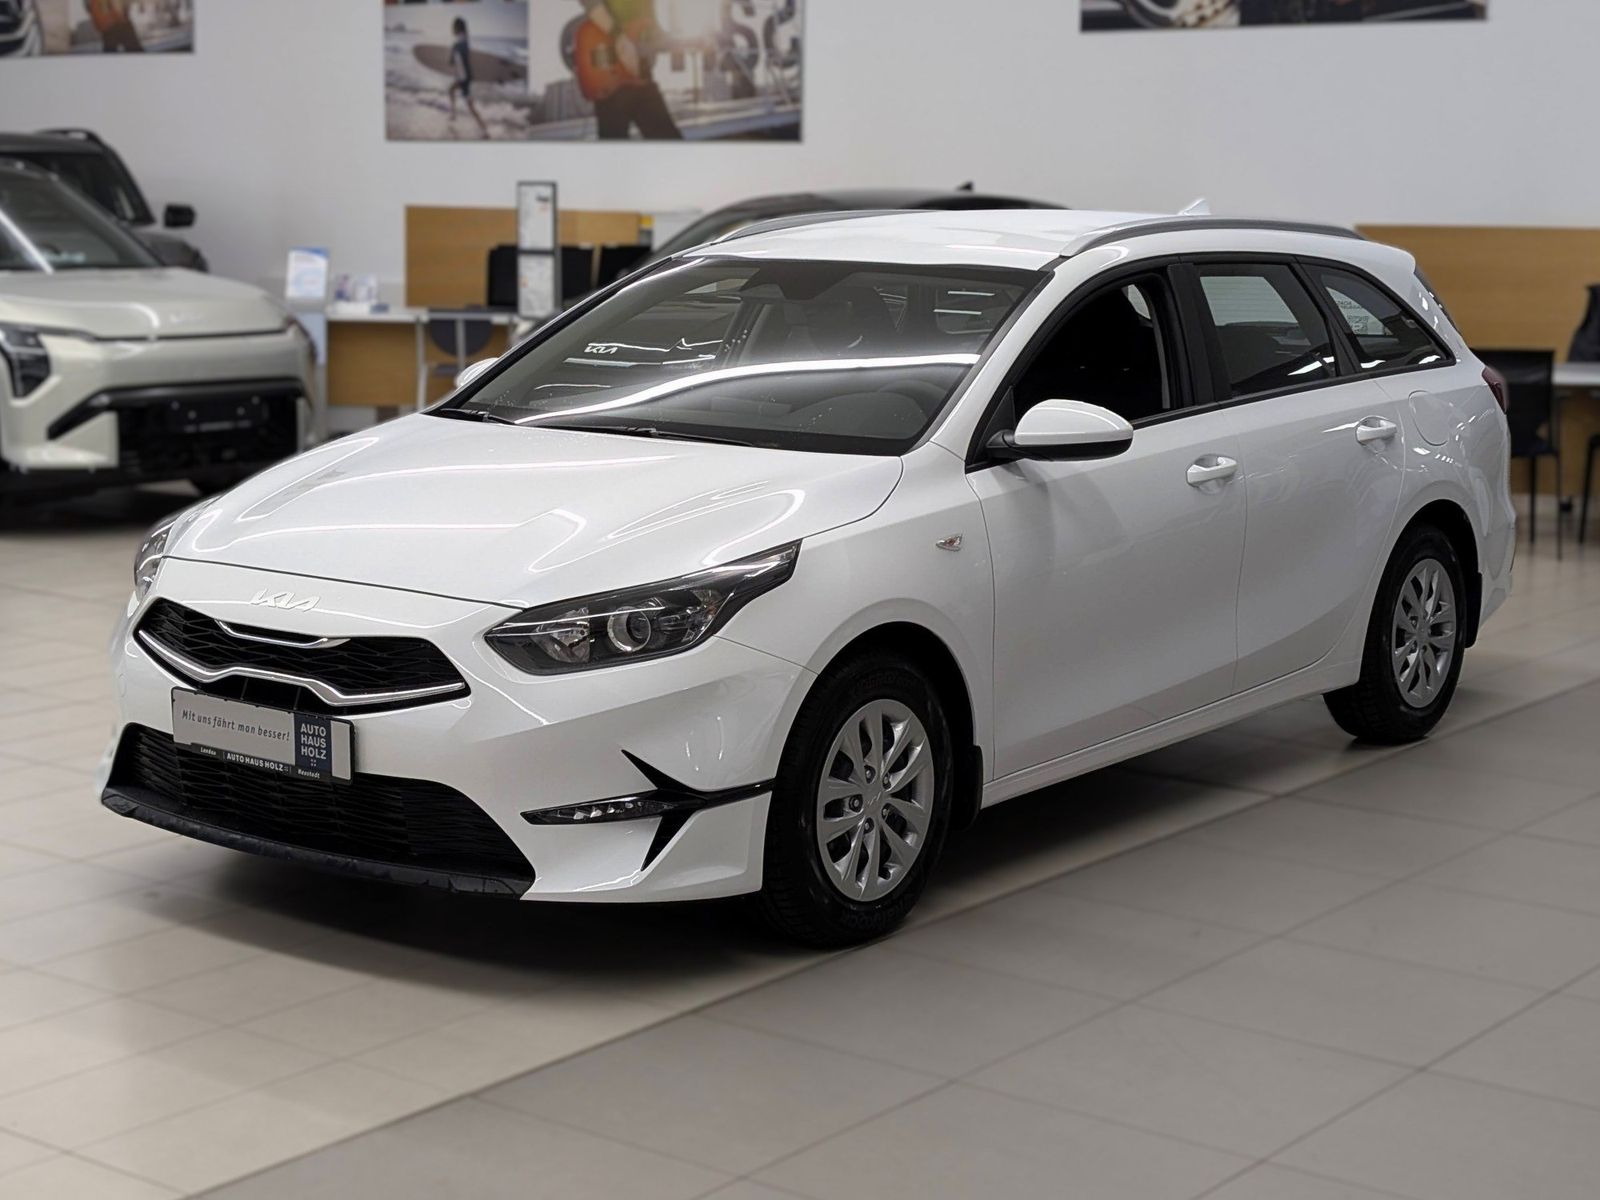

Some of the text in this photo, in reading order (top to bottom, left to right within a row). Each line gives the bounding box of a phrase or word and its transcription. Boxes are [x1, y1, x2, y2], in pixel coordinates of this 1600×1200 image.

[250, 588, 321, 612] KIA
[182, 709, 290, 741] Mit uns fährt man besser!
[300, 723, 327, 737] AUTO
[300, 734, 327, 749] HAUS
[301, 745, 327, 760] HOLZ
[264, 761, 284, 772] HOLZ
